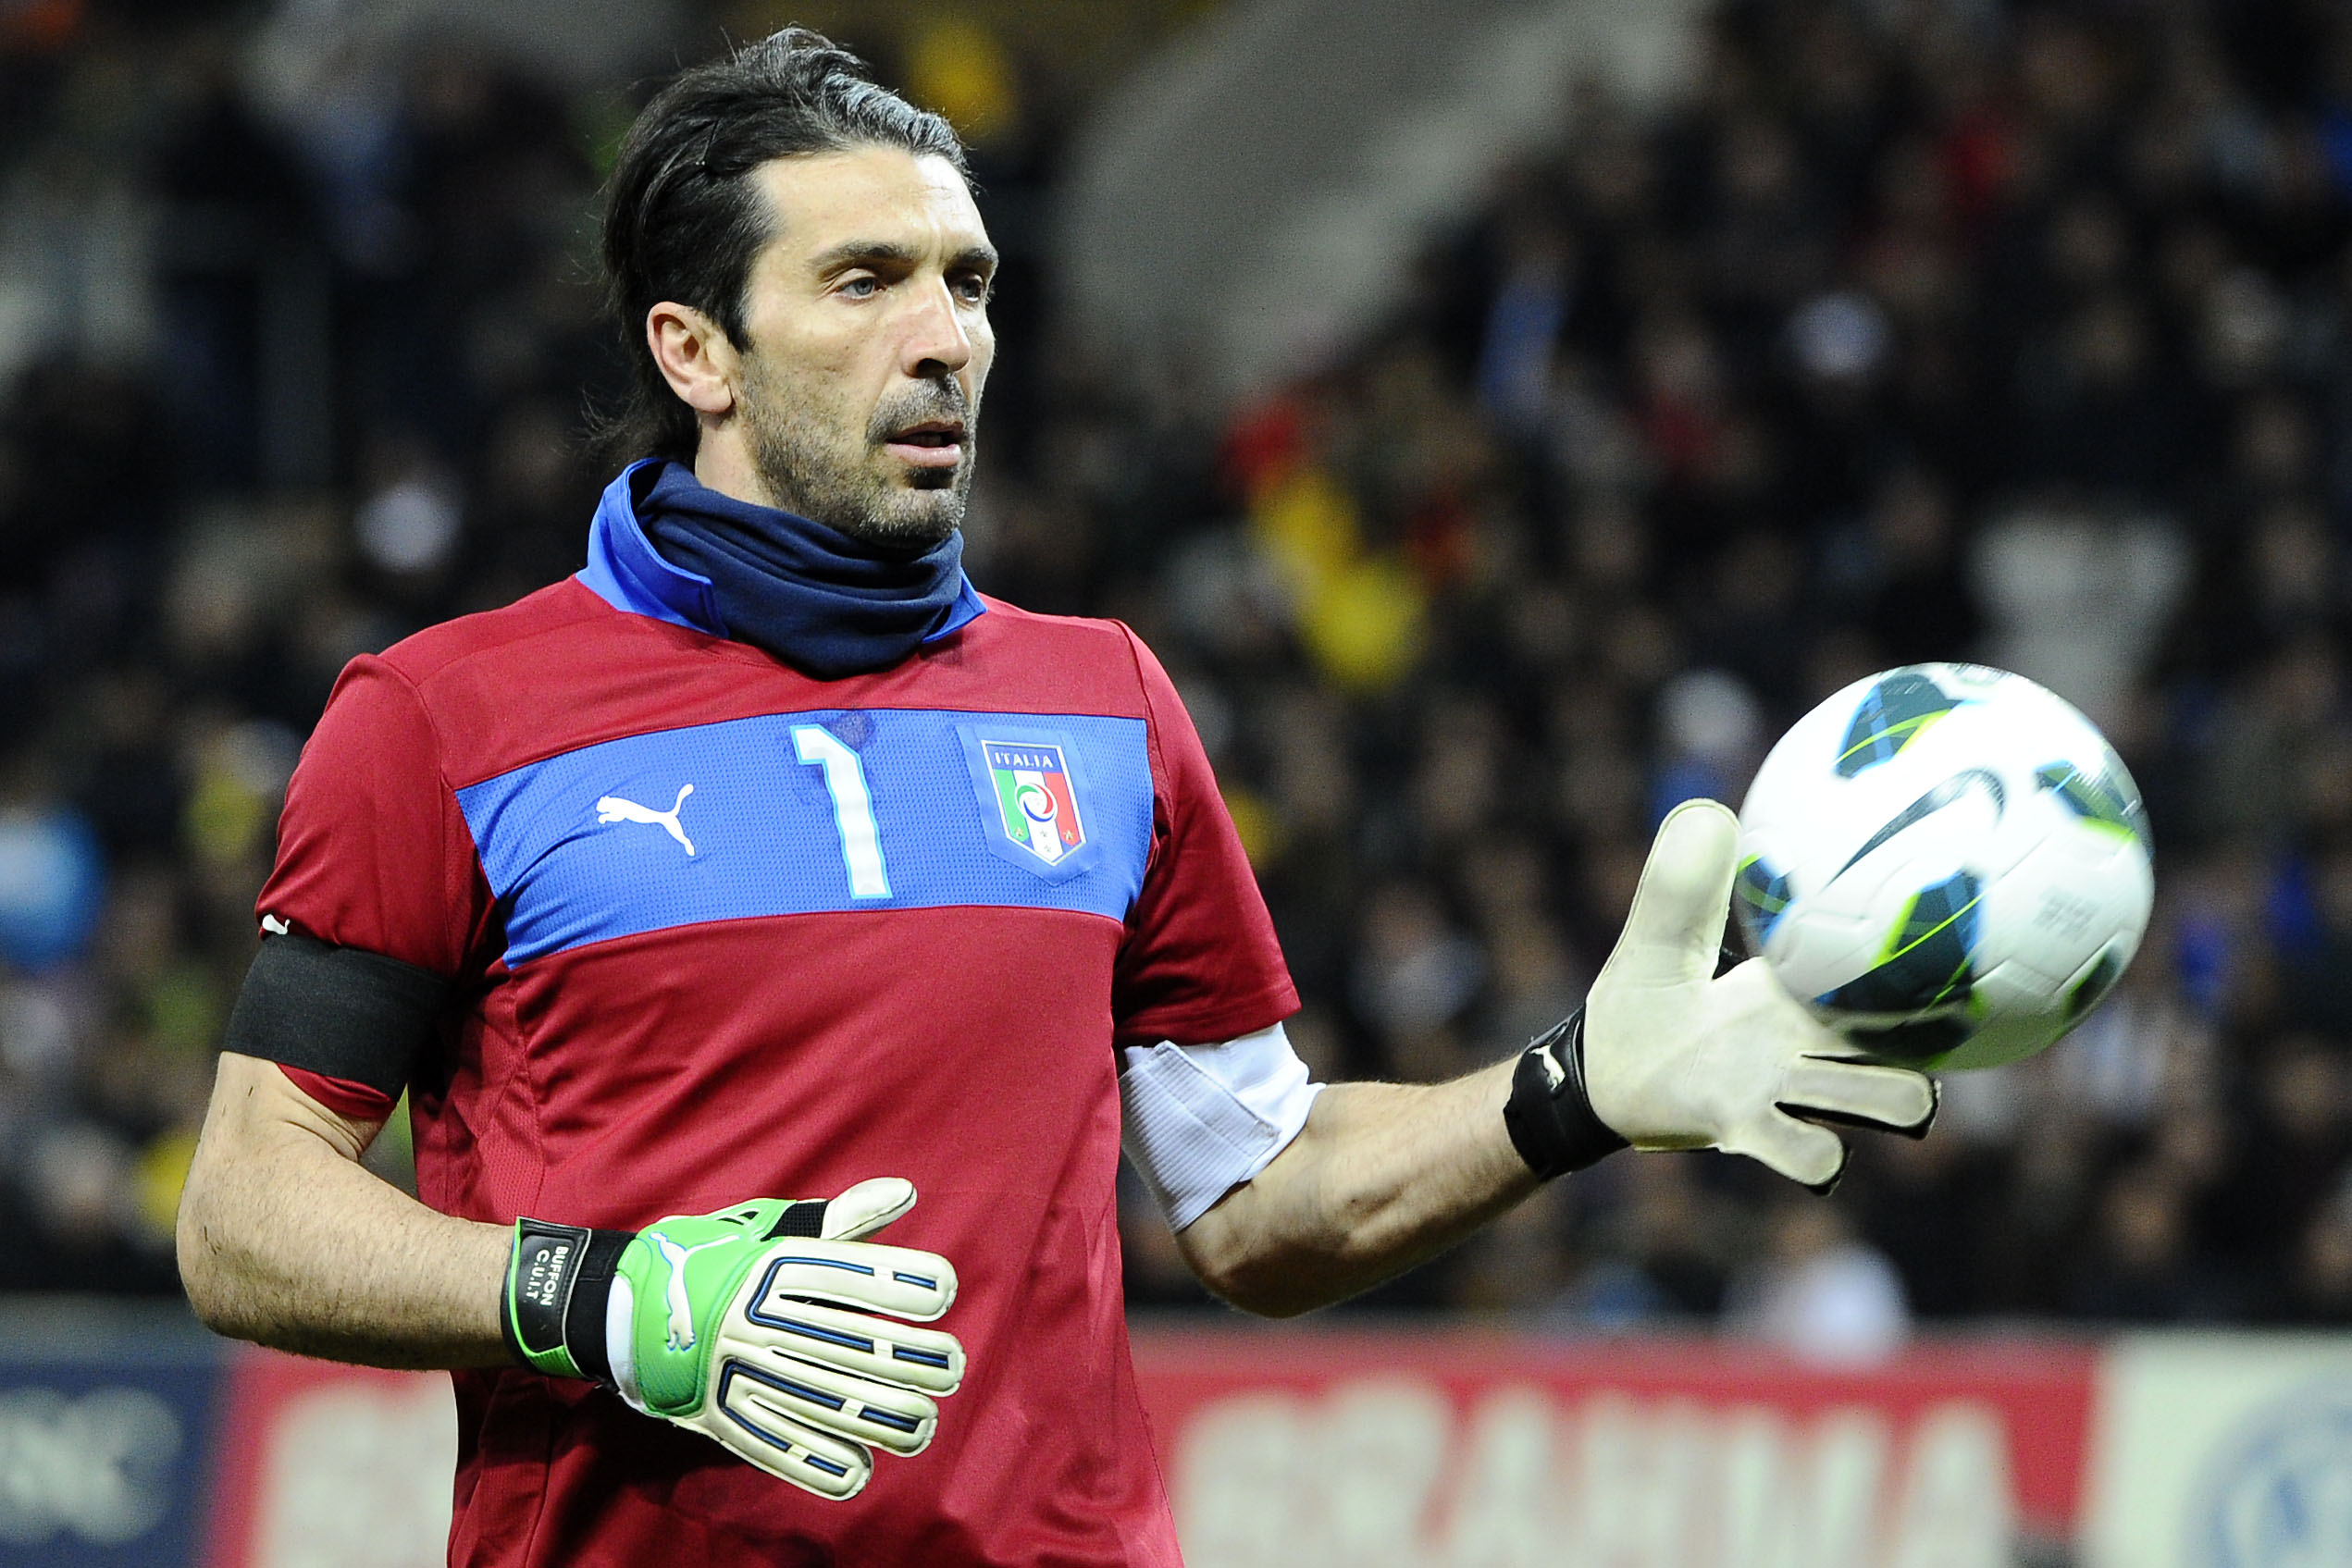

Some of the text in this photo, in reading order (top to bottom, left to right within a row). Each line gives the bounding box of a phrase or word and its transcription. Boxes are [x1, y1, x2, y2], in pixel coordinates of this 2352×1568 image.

[994, 751, 1053, 768] ITALIA
[789, 723, 893, 899] 1
[539, 1245, 570, 1306] BUFFON
